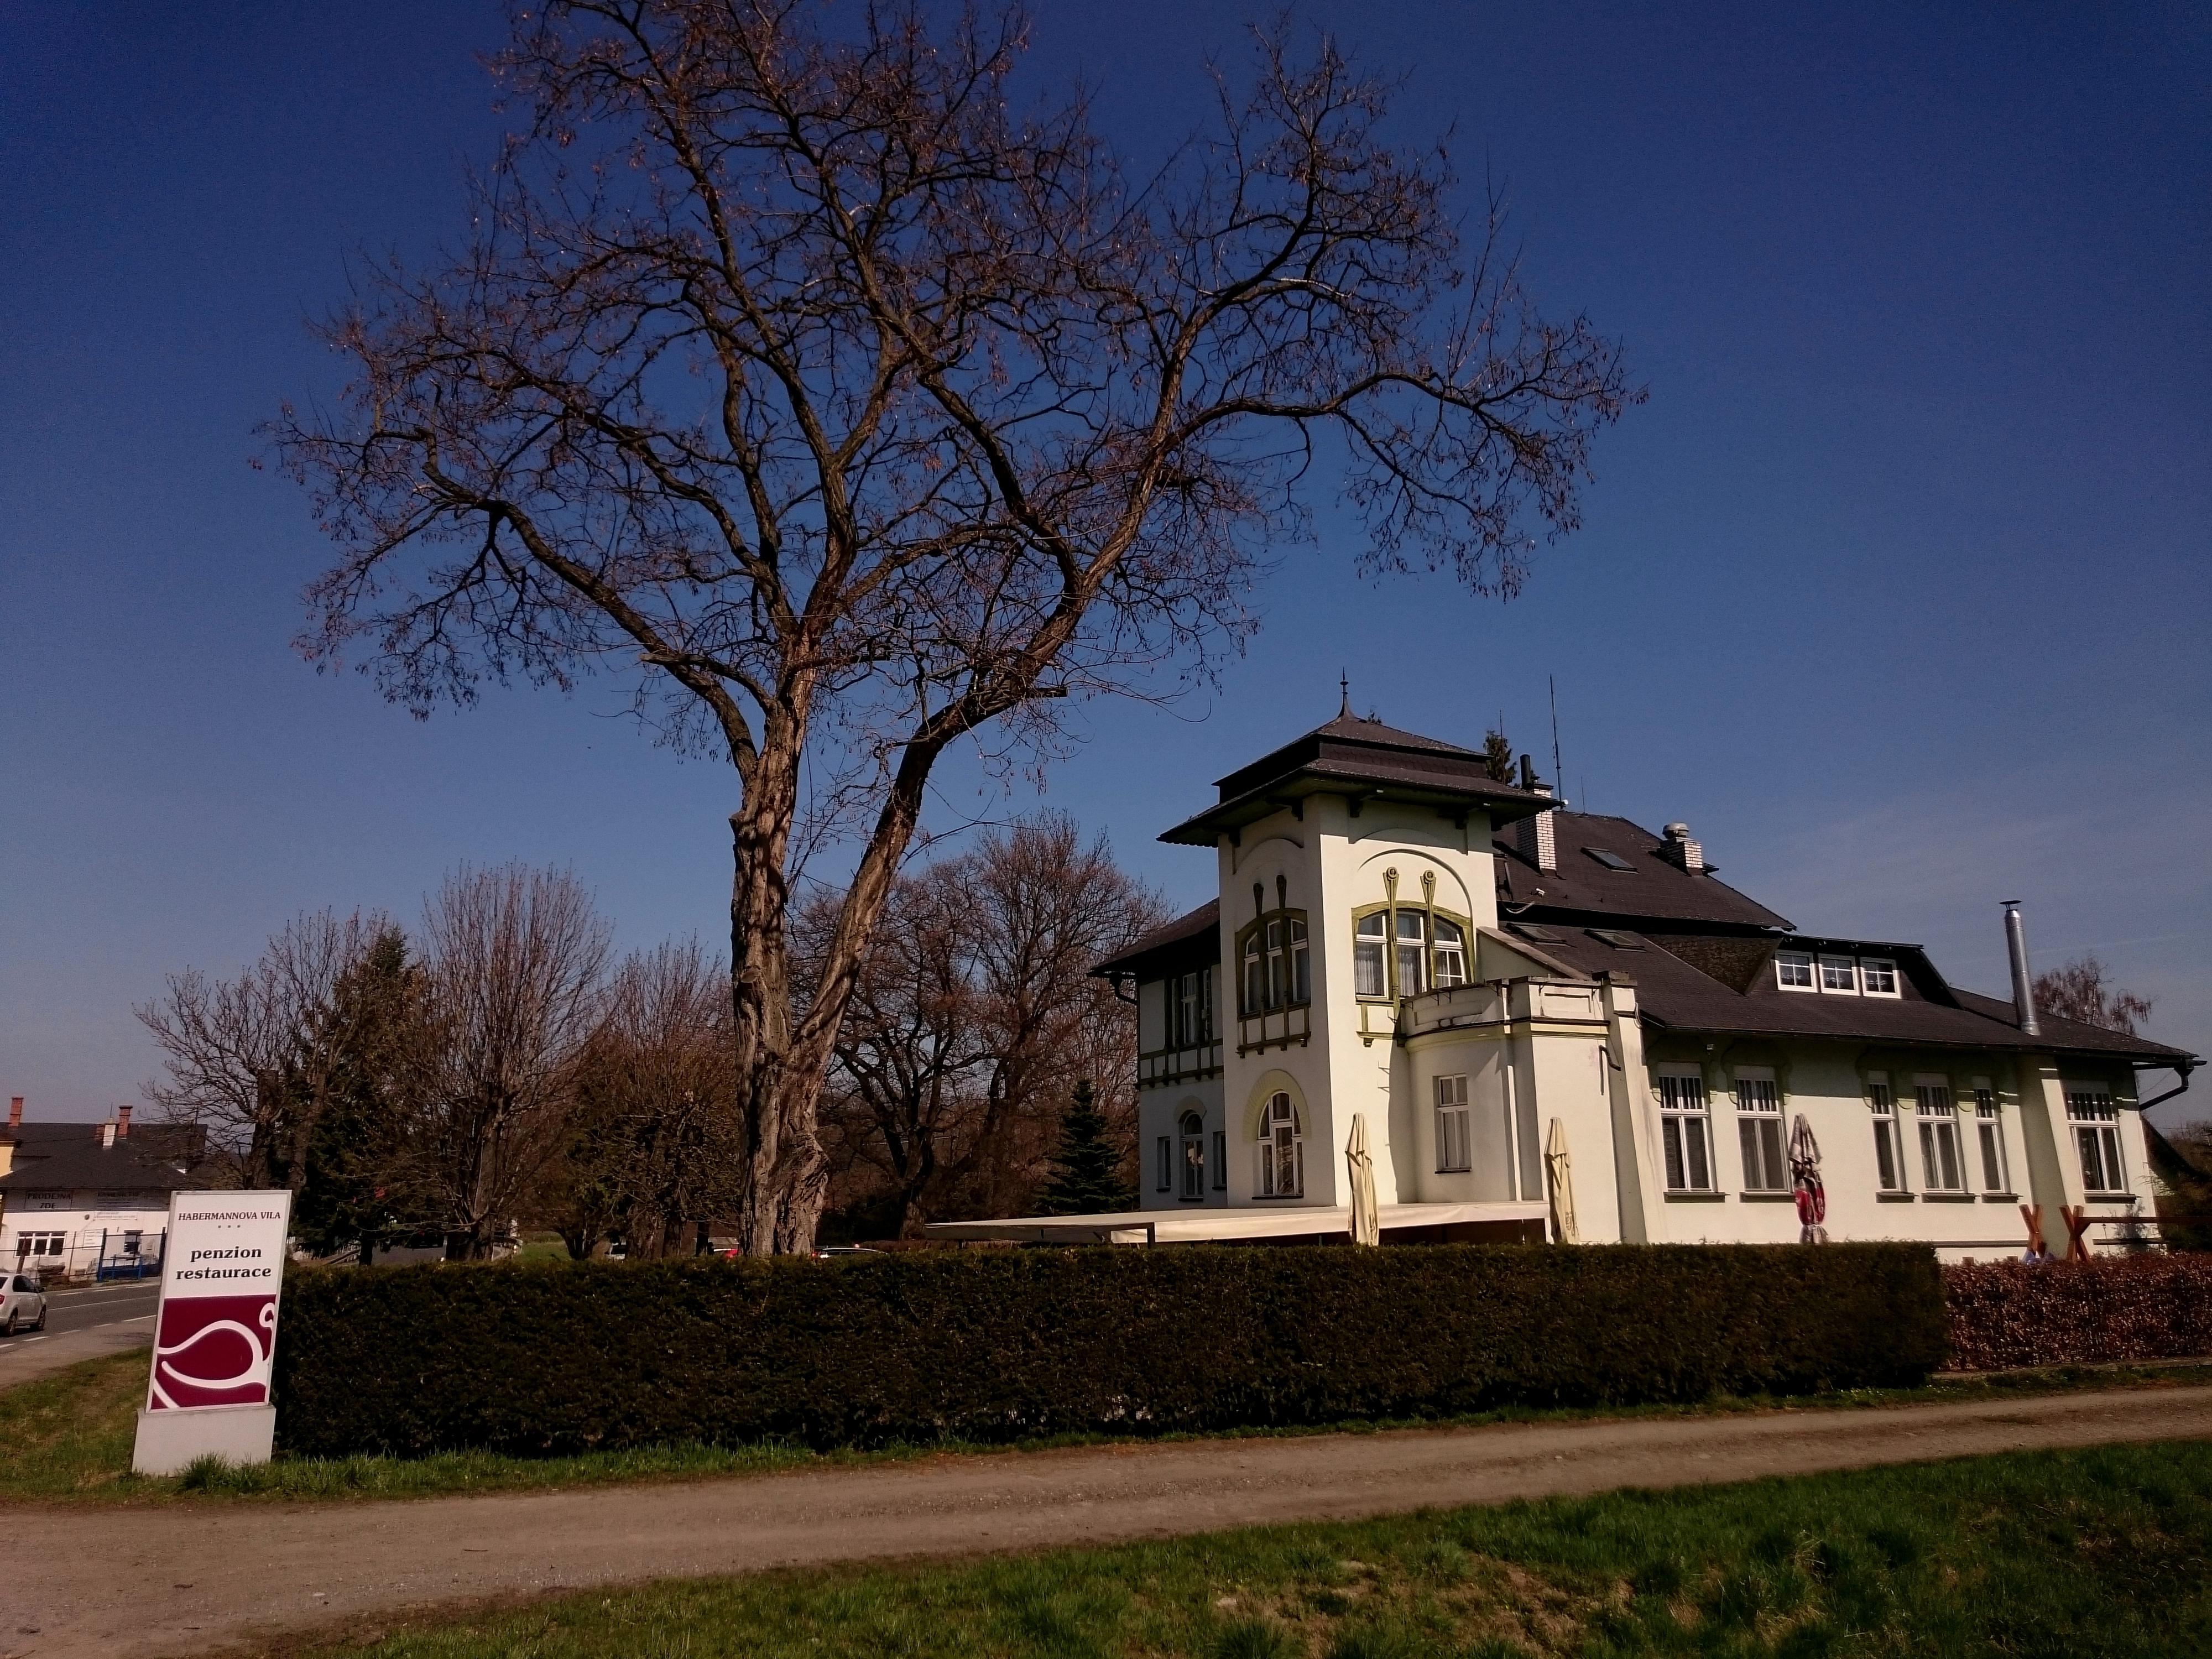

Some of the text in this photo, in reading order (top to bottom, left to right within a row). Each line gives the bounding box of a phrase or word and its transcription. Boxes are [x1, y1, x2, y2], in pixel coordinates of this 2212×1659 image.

[178, 1212, 257, 1220] HABERMANNOVA
[190, 1246, 262, 1262] penzion
[176, 1267, 271, 1279] restaurace
